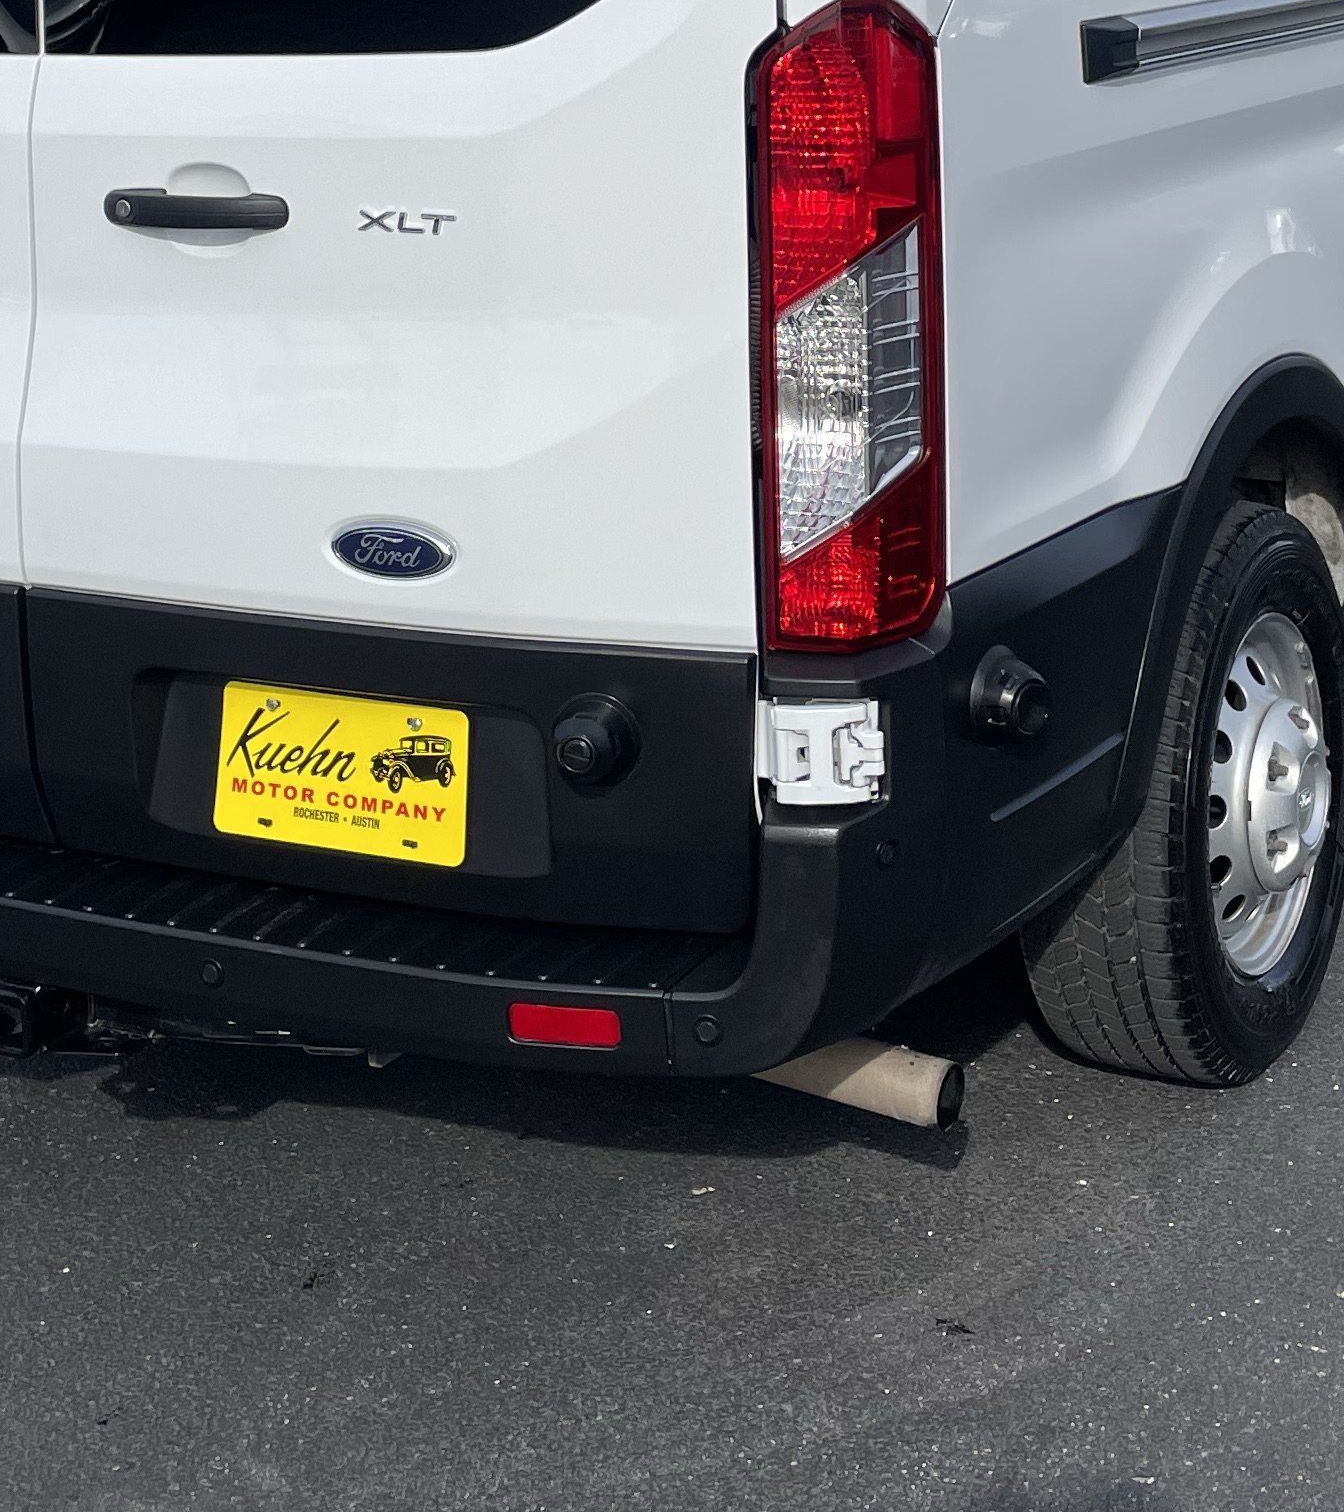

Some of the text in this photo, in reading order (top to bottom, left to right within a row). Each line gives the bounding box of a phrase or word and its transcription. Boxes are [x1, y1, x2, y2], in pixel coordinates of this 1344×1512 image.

[357, 209, 458, 236] XLT
[354, 533, 422, 568] Ford
[226, 706, 358, 783] Kuehn
[231, 776, 447, 823] MOTOR COMPANY
[292, 806, 382, 831] ROCHESTER AUSTIN
